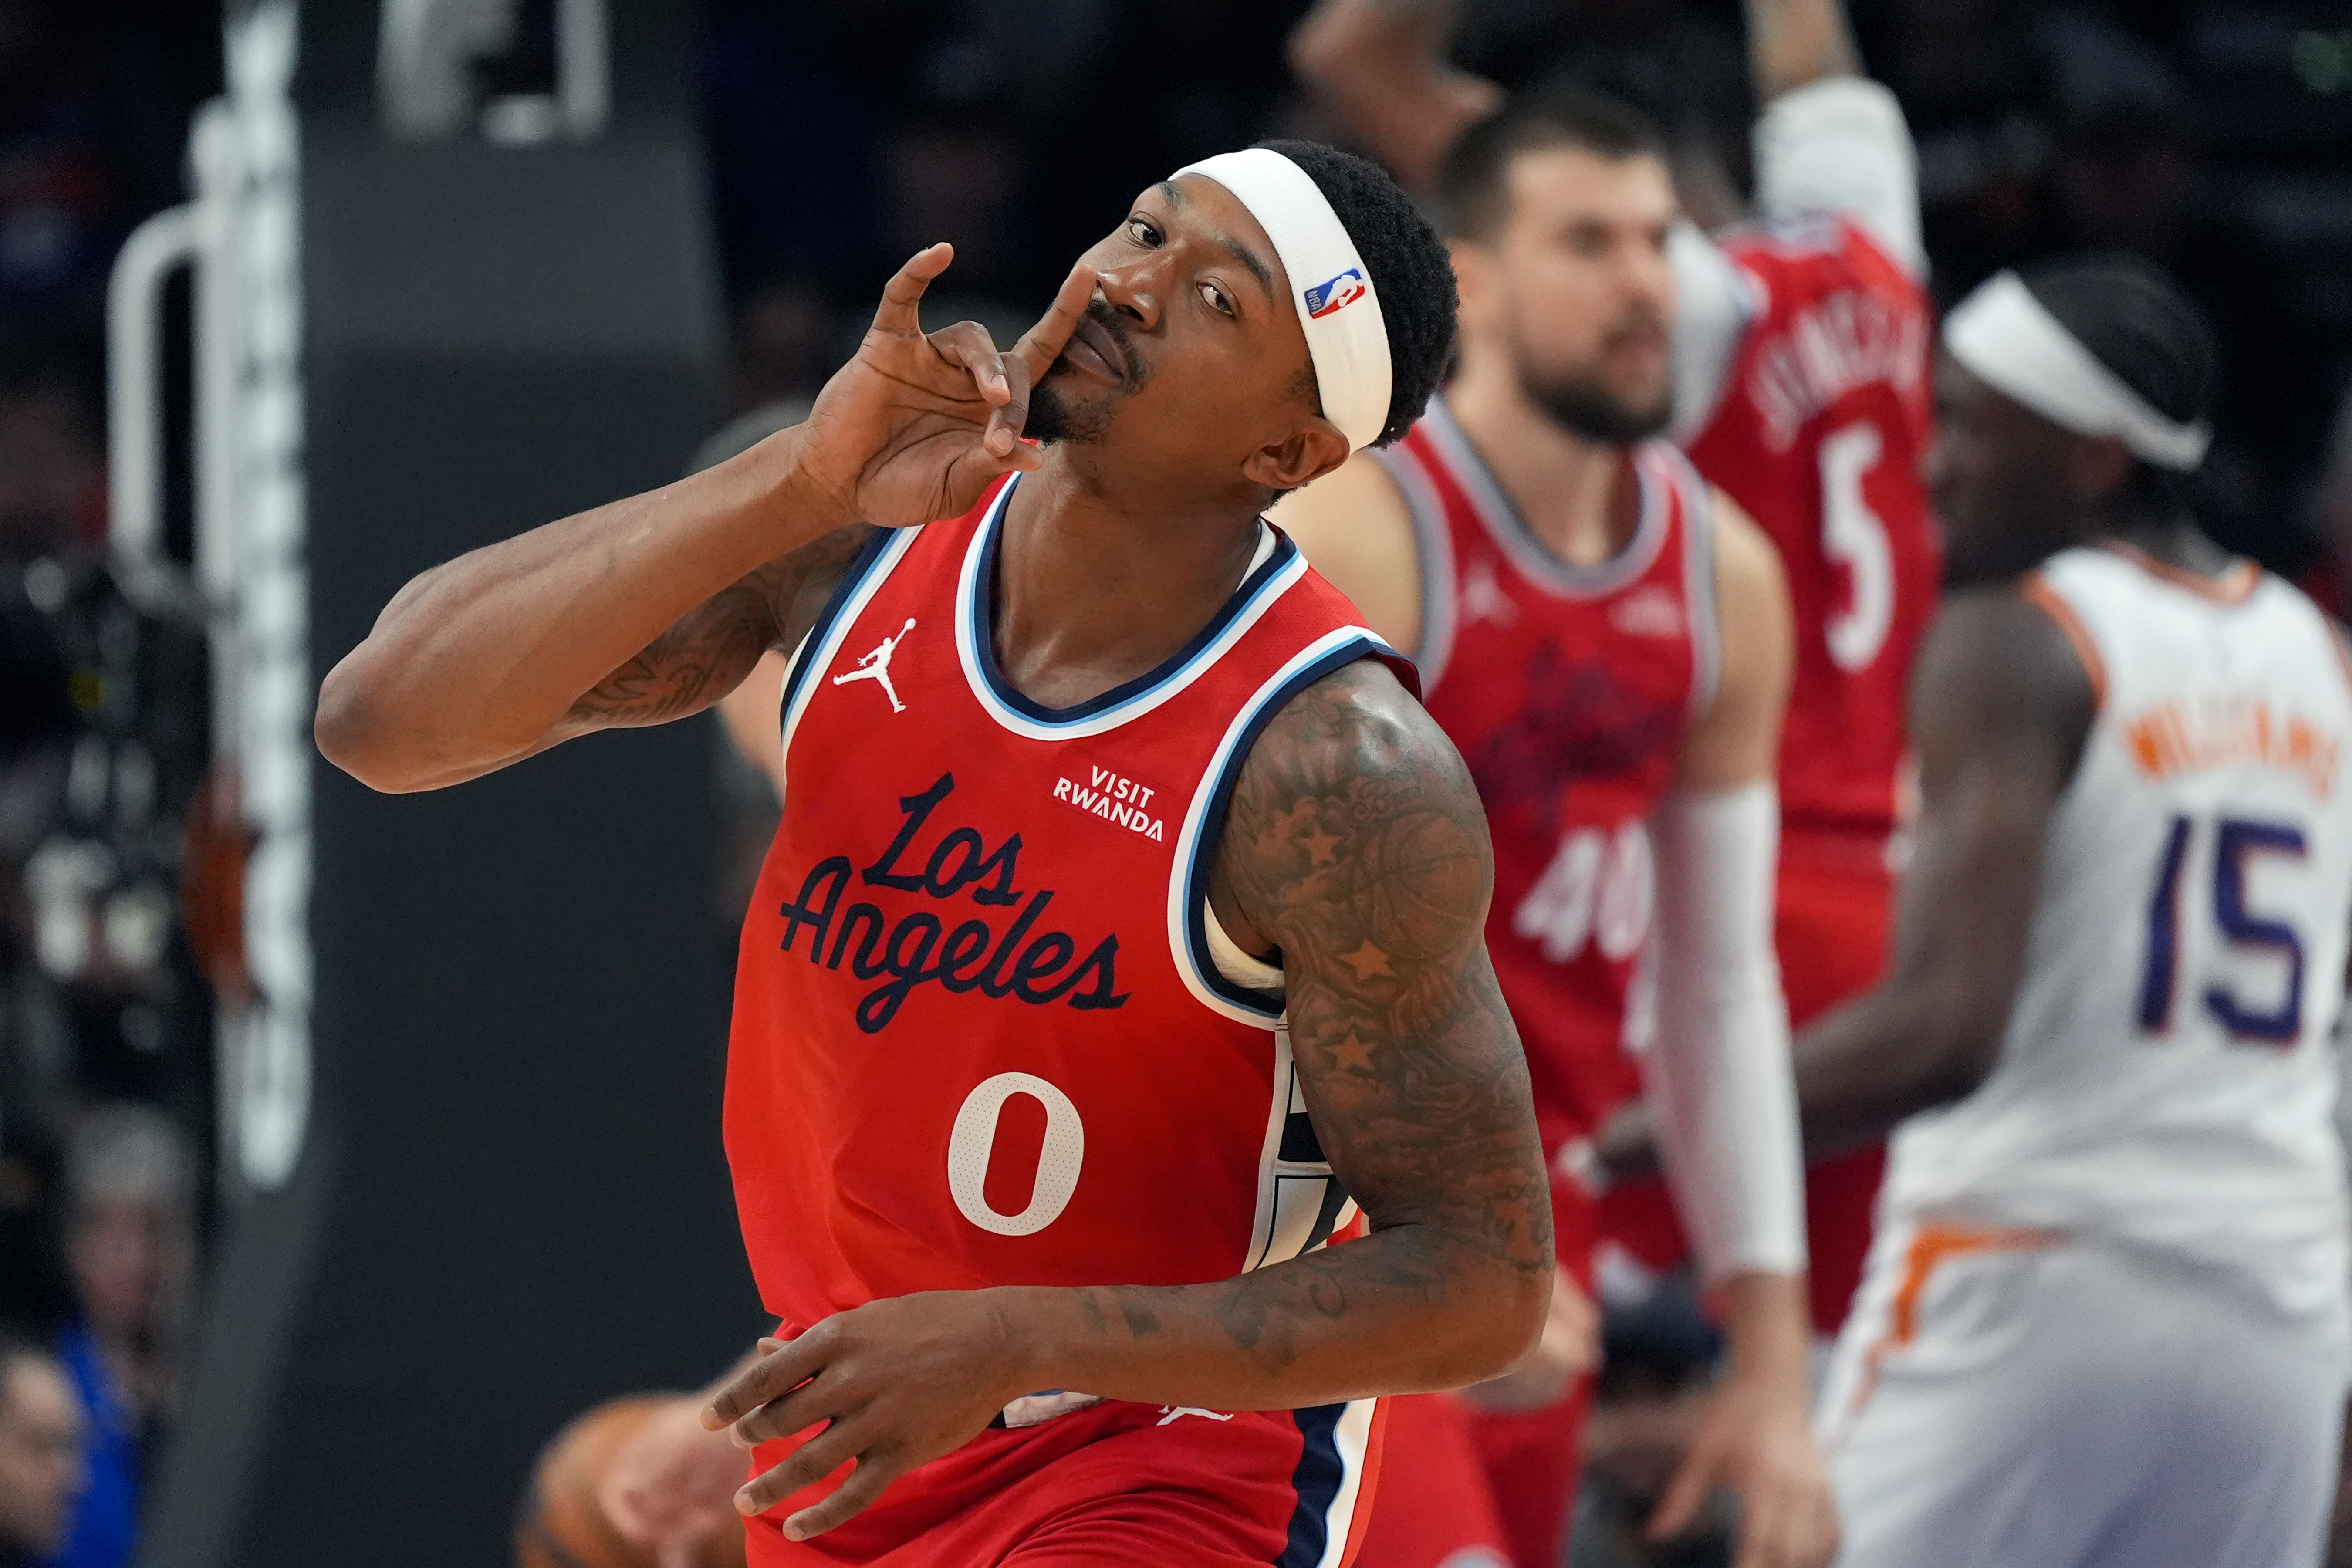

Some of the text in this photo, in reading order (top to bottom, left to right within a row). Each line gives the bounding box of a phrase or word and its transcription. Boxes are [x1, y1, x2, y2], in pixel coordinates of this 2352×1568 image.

[1308, 290, 1321, 310] NBA
[1817, 421, 1896, 672] 5
[861, 772, 1025, 906] Los
[1053, 777, 1163, 842] RWANDA
[1092, 765, 1155, 808] VISIT
[780, 856, 1132, 1034] Angeles
[1513, 817, 1654, 963] 40
[2137, 814, 2308, 1052] 15
[948, 1071, 1084, 1236] 0
